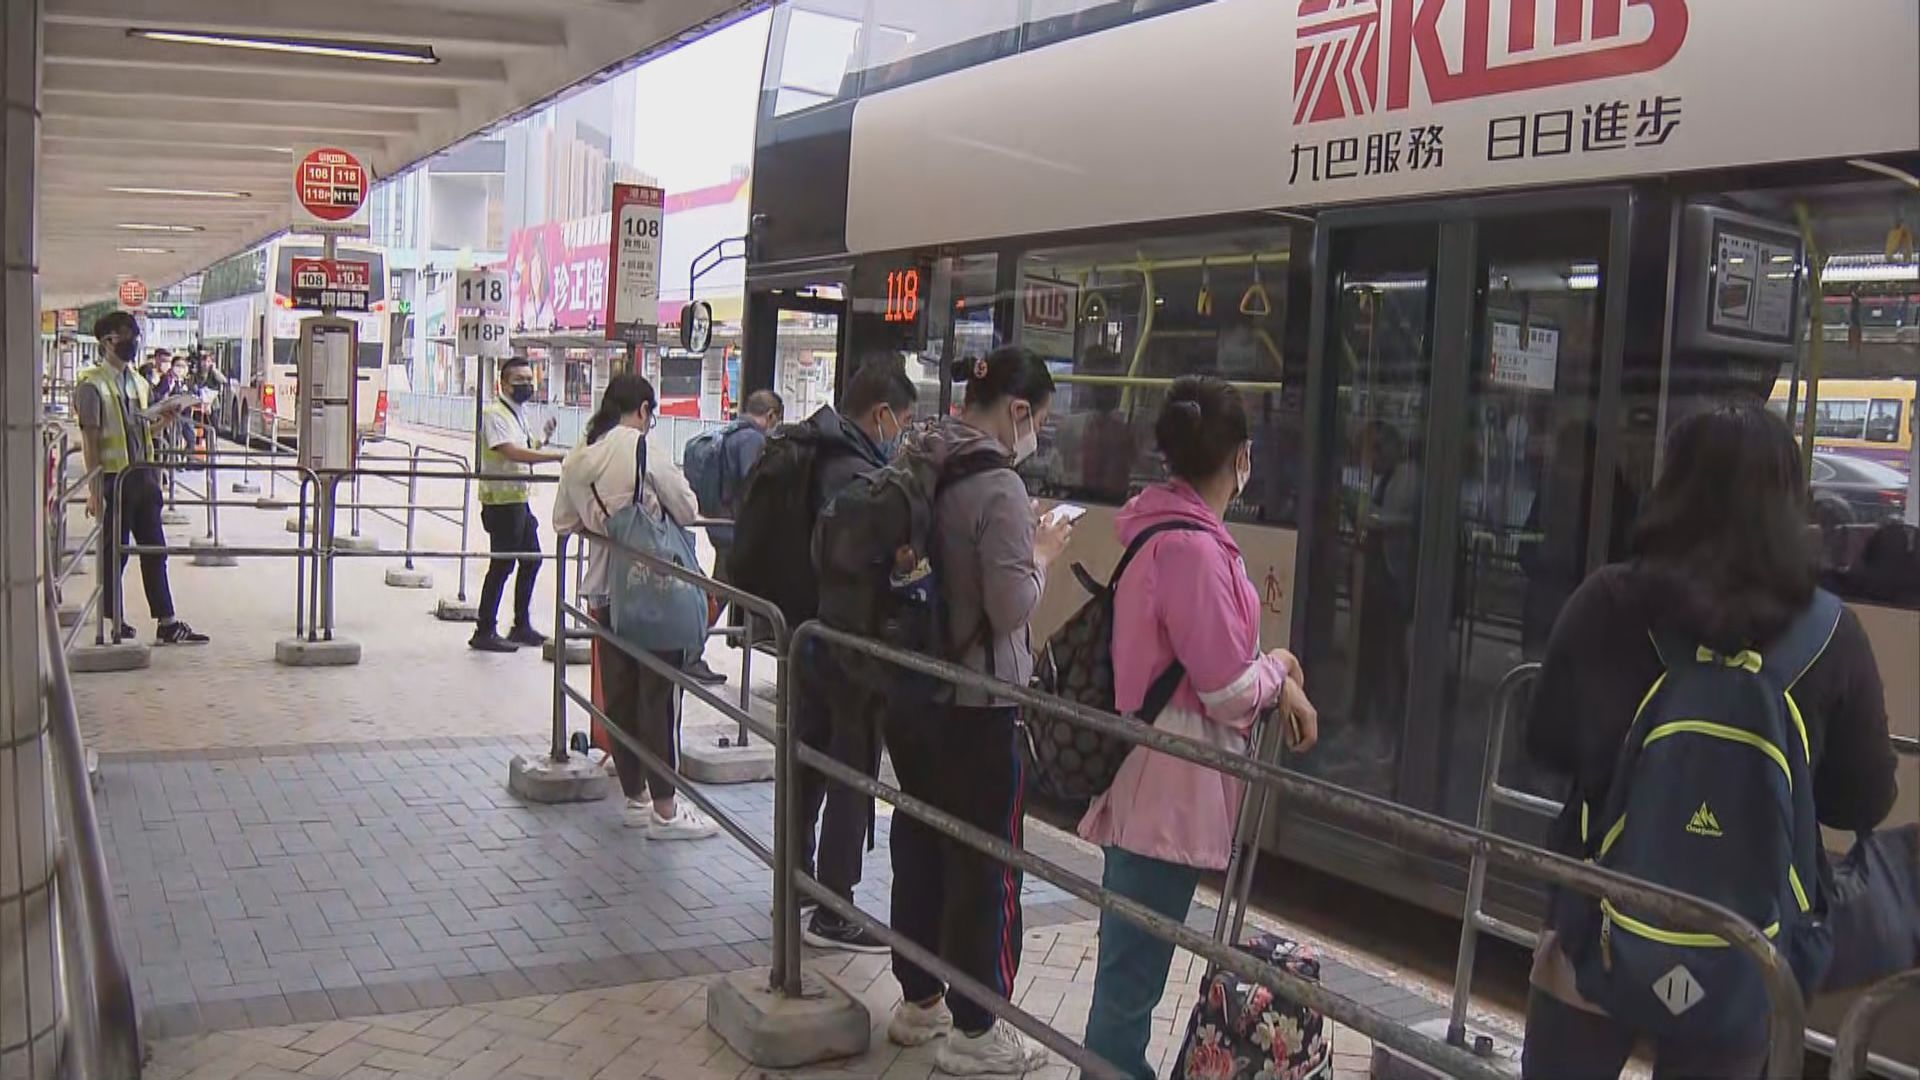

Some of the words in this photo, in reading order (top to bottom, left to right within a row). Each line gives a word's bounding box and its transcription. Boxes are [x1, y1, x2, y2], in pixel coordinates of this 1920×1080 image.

[1287, 123, 1445, 186] 九巴服務
[1486, 95, 1683, 162] 日日進步
[309, 167, 328, 180] 108
[337, 170, 356, 181] 118
[333, 191, 359, 202] N118
[623, 217, 659, 238] 108
[301, 274, 323, 286] 108
[461, 278, 503, 301] 118
[553, 259, 607, 313] 珍正陪
[885, 269, 919, 322] 118
[461, 323, 505, 341] 118P
